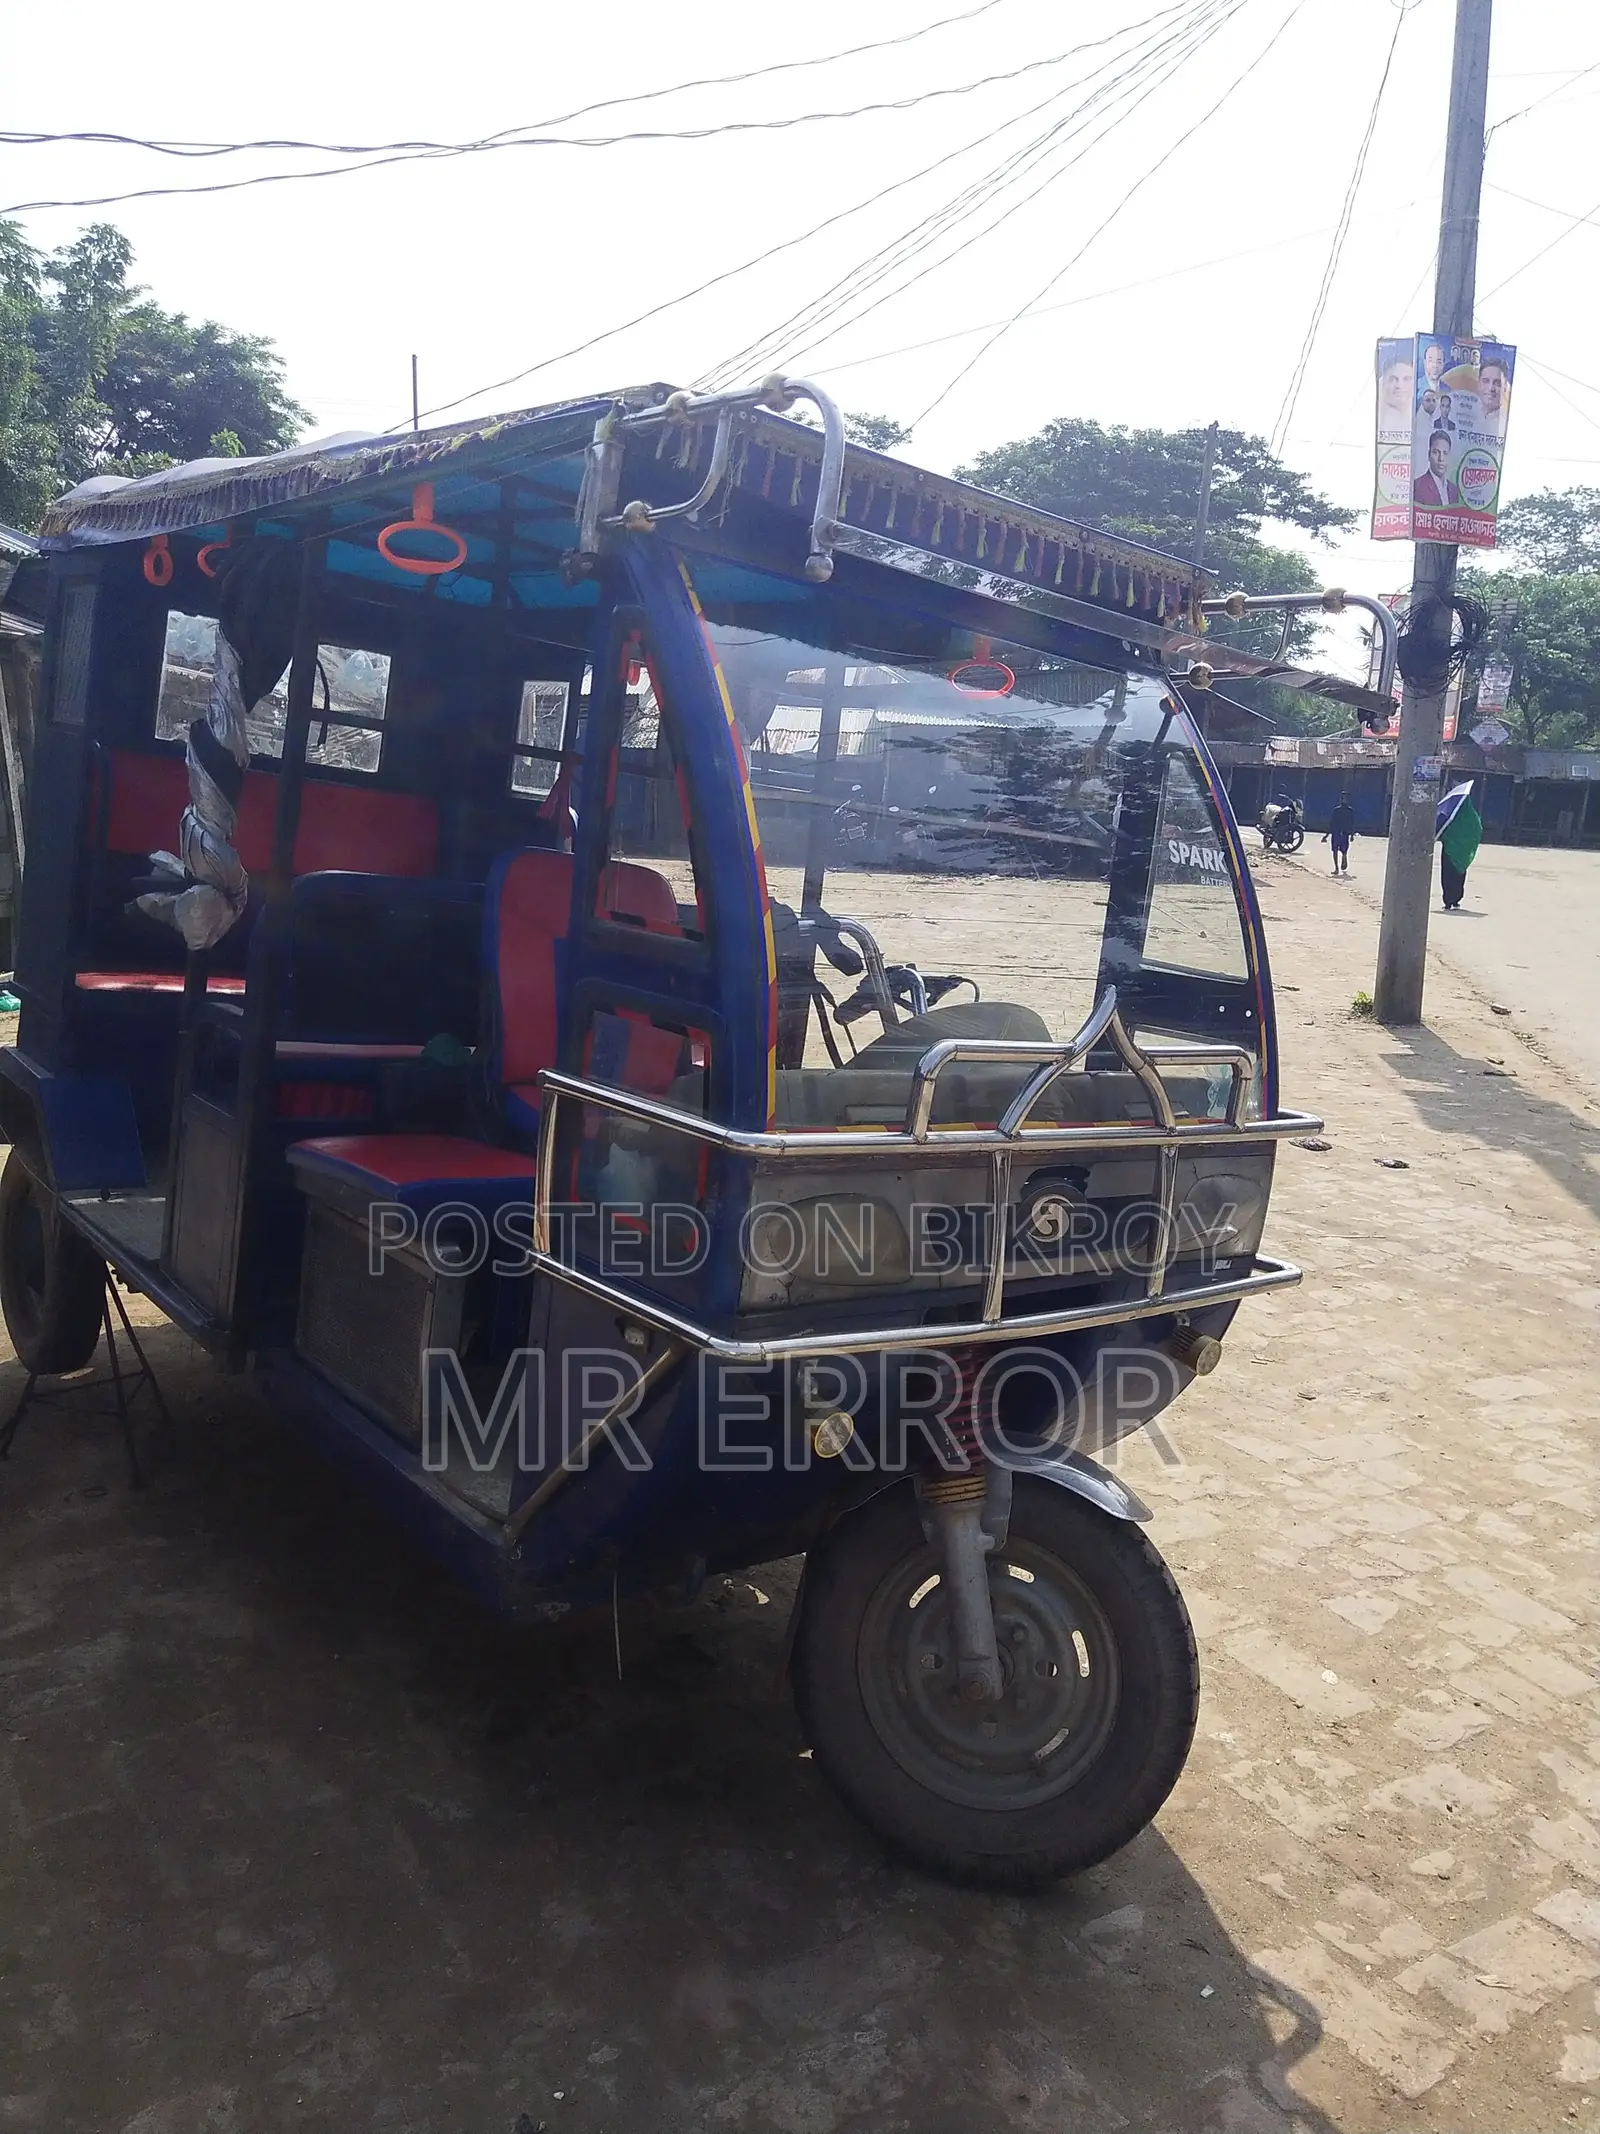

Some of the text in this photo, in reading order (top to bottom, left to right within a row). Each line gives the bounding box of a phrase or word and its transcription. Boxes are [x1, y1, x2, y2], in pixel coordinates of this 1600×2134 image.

[1415, 512, 1432, 528] মোঃ
[1433, 514, 1459, 531] হেলাল
[1168, 840, 1228, 873] SPARK
